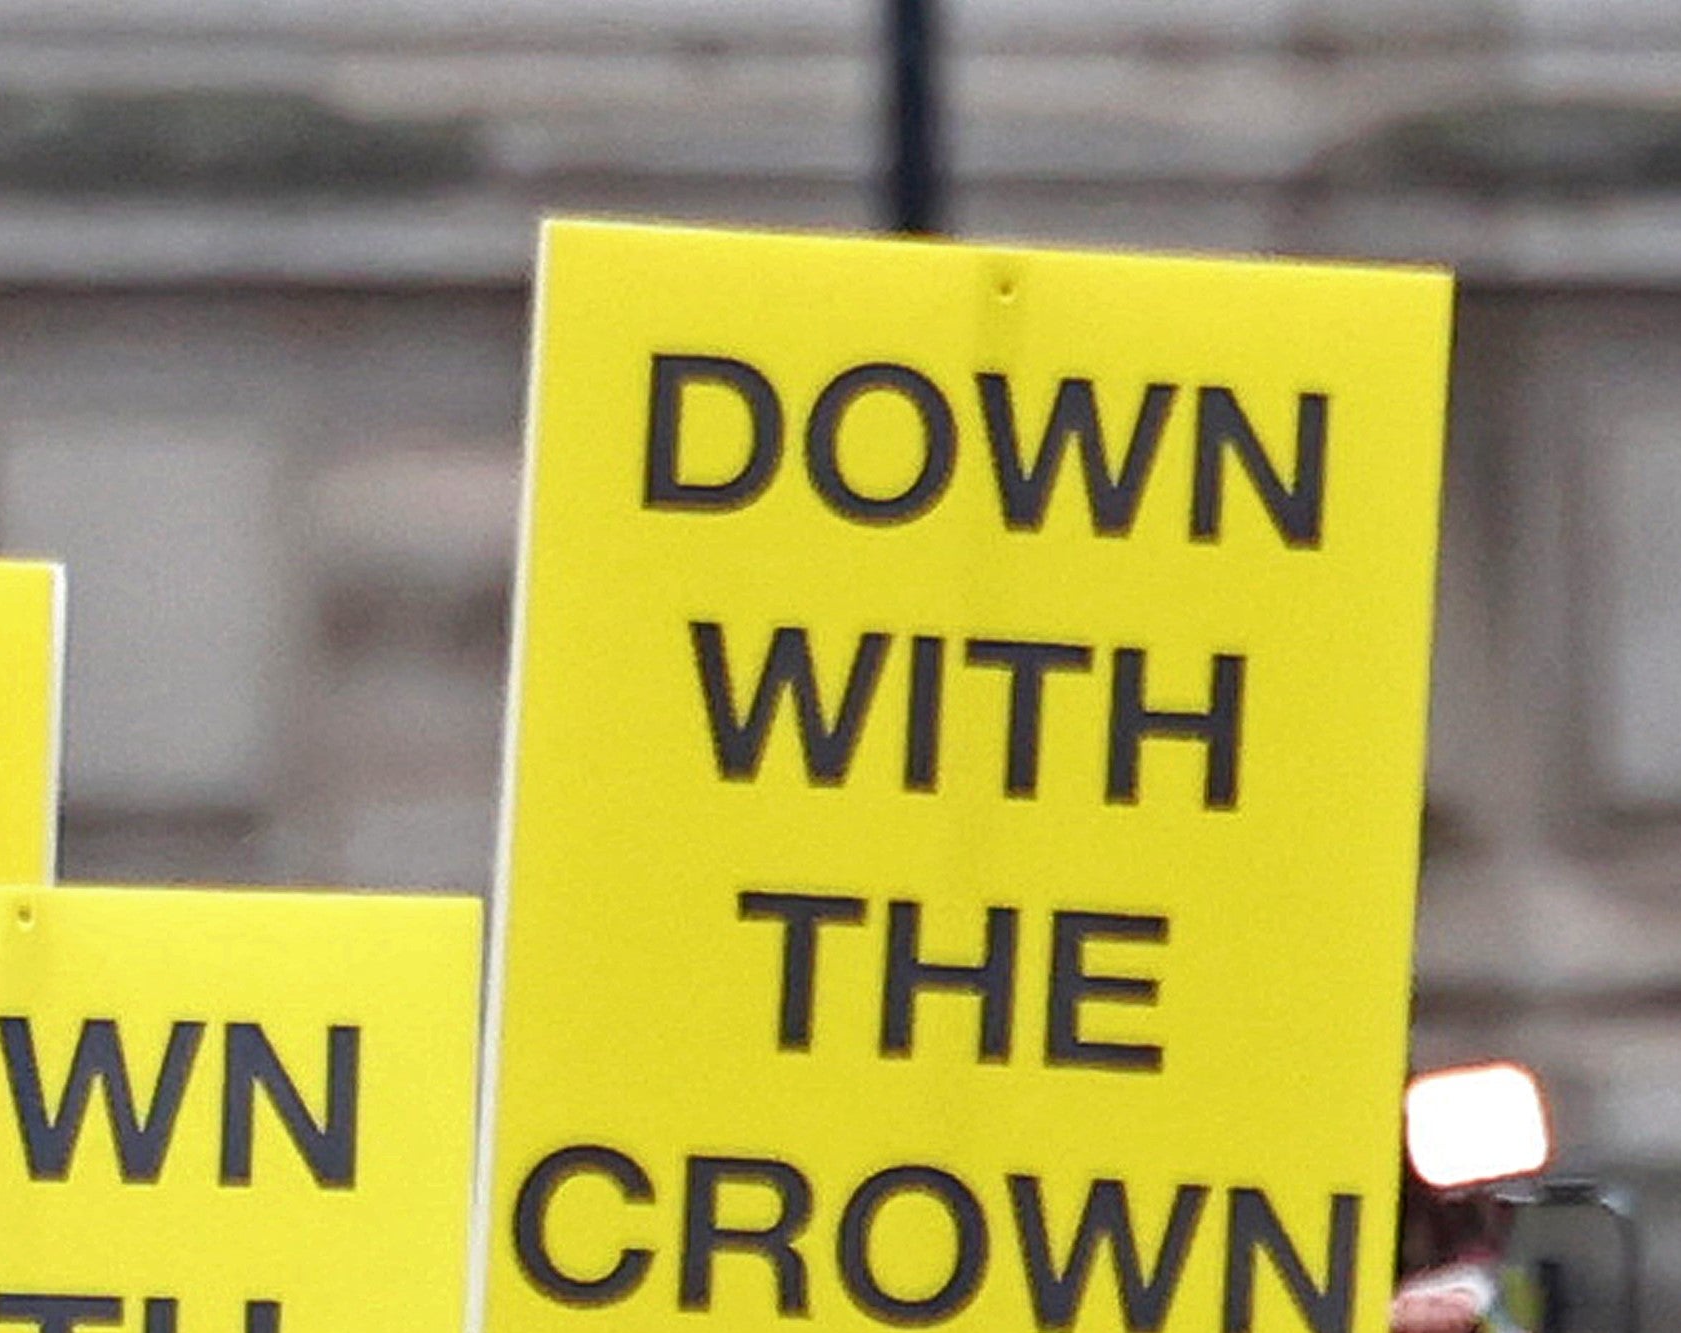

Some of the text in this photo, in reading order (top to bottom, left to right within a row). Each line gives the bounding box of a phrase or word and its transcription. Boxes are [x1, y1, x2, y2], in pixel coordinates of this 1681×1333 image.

[644, 354, 1328, 547] DOWN
[690, 622, 1245, 810] WITH
[738, 891, 1168, 1071] THE
